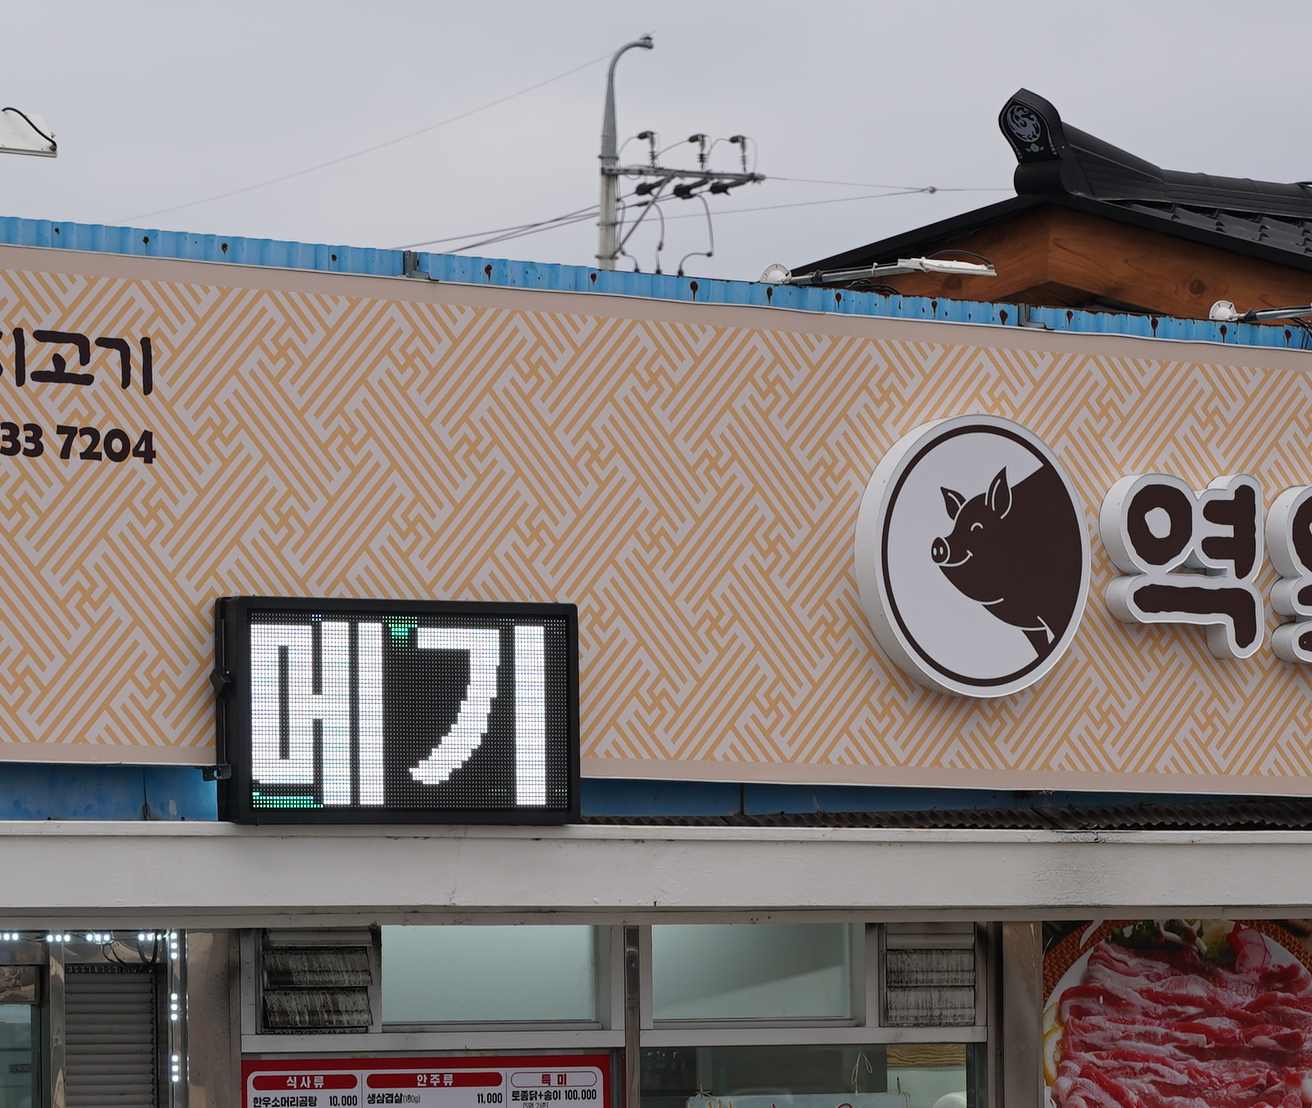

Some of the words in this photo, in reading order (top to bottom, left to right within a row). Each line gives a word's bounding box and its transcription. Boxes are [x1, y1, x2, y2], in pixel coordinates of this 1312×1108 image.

[57, 426, 156, 464] 7204
[251, 621, 546, 806] 메기
[286, 1076, 324, 1088] 식사류
[417, 1074, 453, 1087] 안주류
[253, 1096, 318, 1108] 한우소머리곰탕
[329, 1095, 358, 1107] 10,000
[477, 1093, 503, 1104] 11,000
[564, 1089, 597, 1101] 100,000
